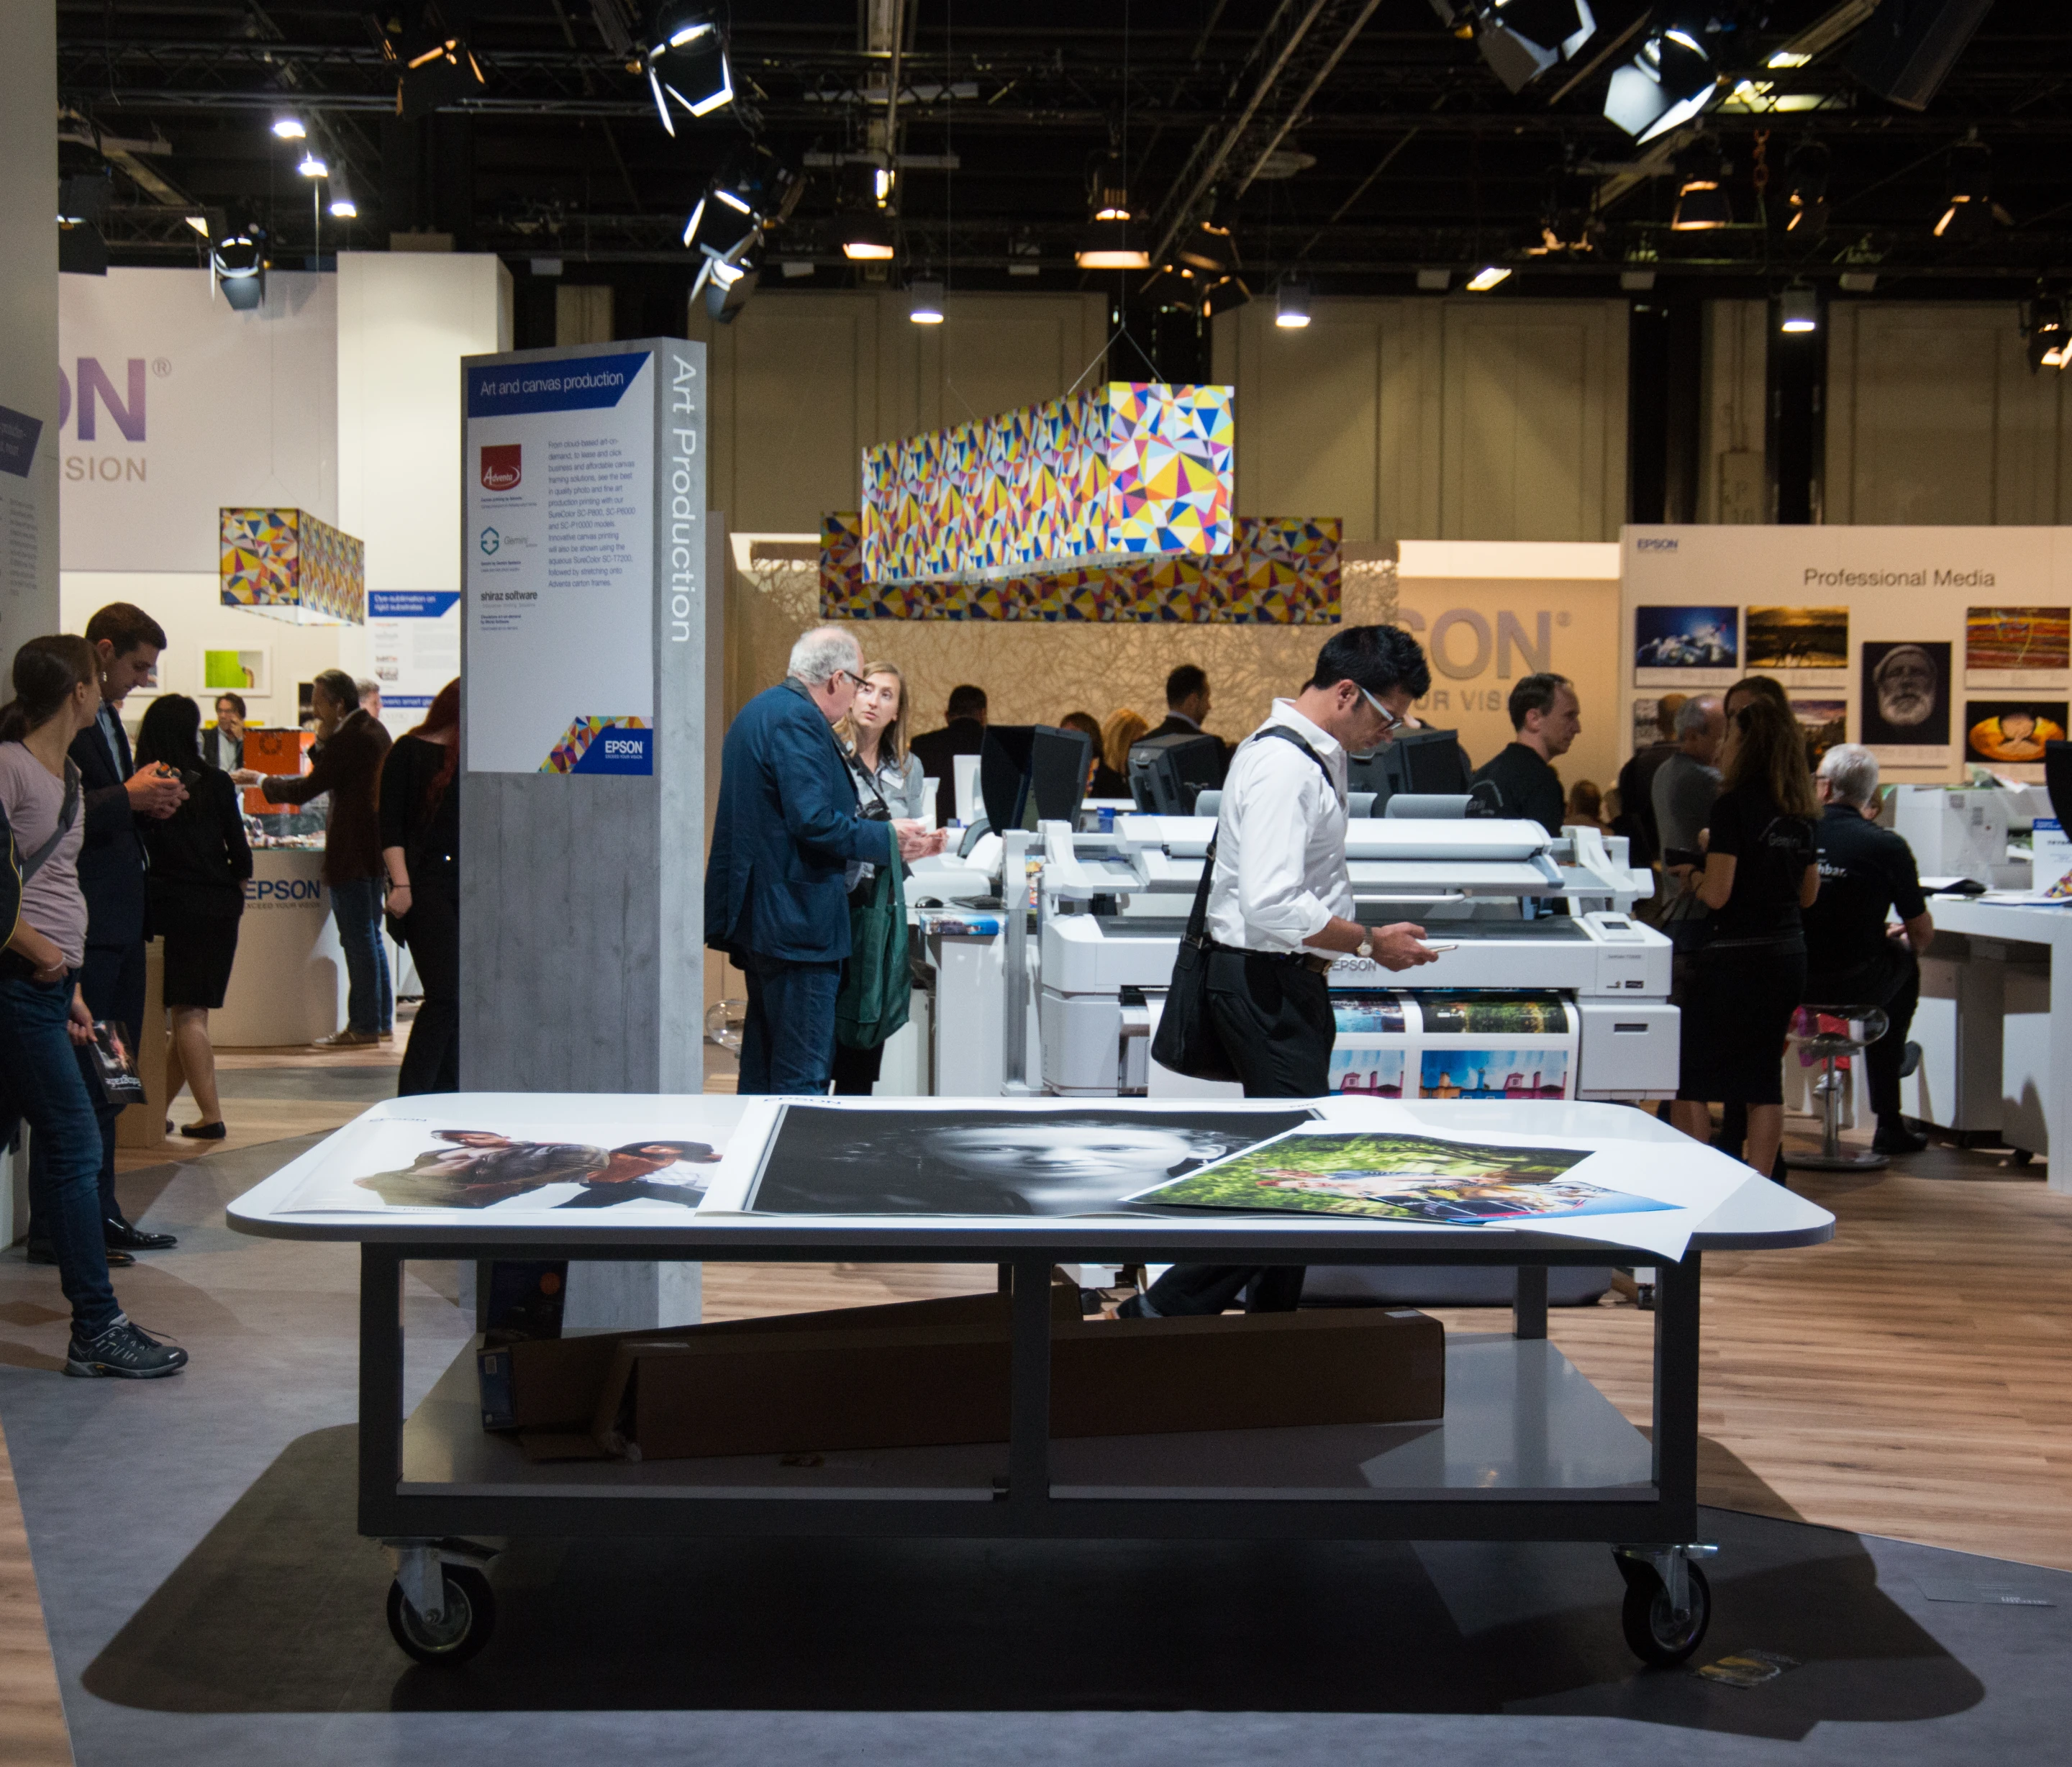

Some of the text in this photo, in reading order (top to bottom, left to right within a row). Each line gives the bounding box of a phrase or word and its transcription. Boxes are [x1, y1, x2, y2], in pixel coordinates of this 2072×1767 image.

[481, 371, 624, 396] Art and canvas production
[671, 354, 696, 642] Art Production
[1804, 568, 1996, 587] Professional Media
[481, 590, 537, 601] shiraz software
[605, 740, 643, 754] EPSON
[245, 880, 320, 900] EPSON
[1332, 960, 1377, 972] EPSON
